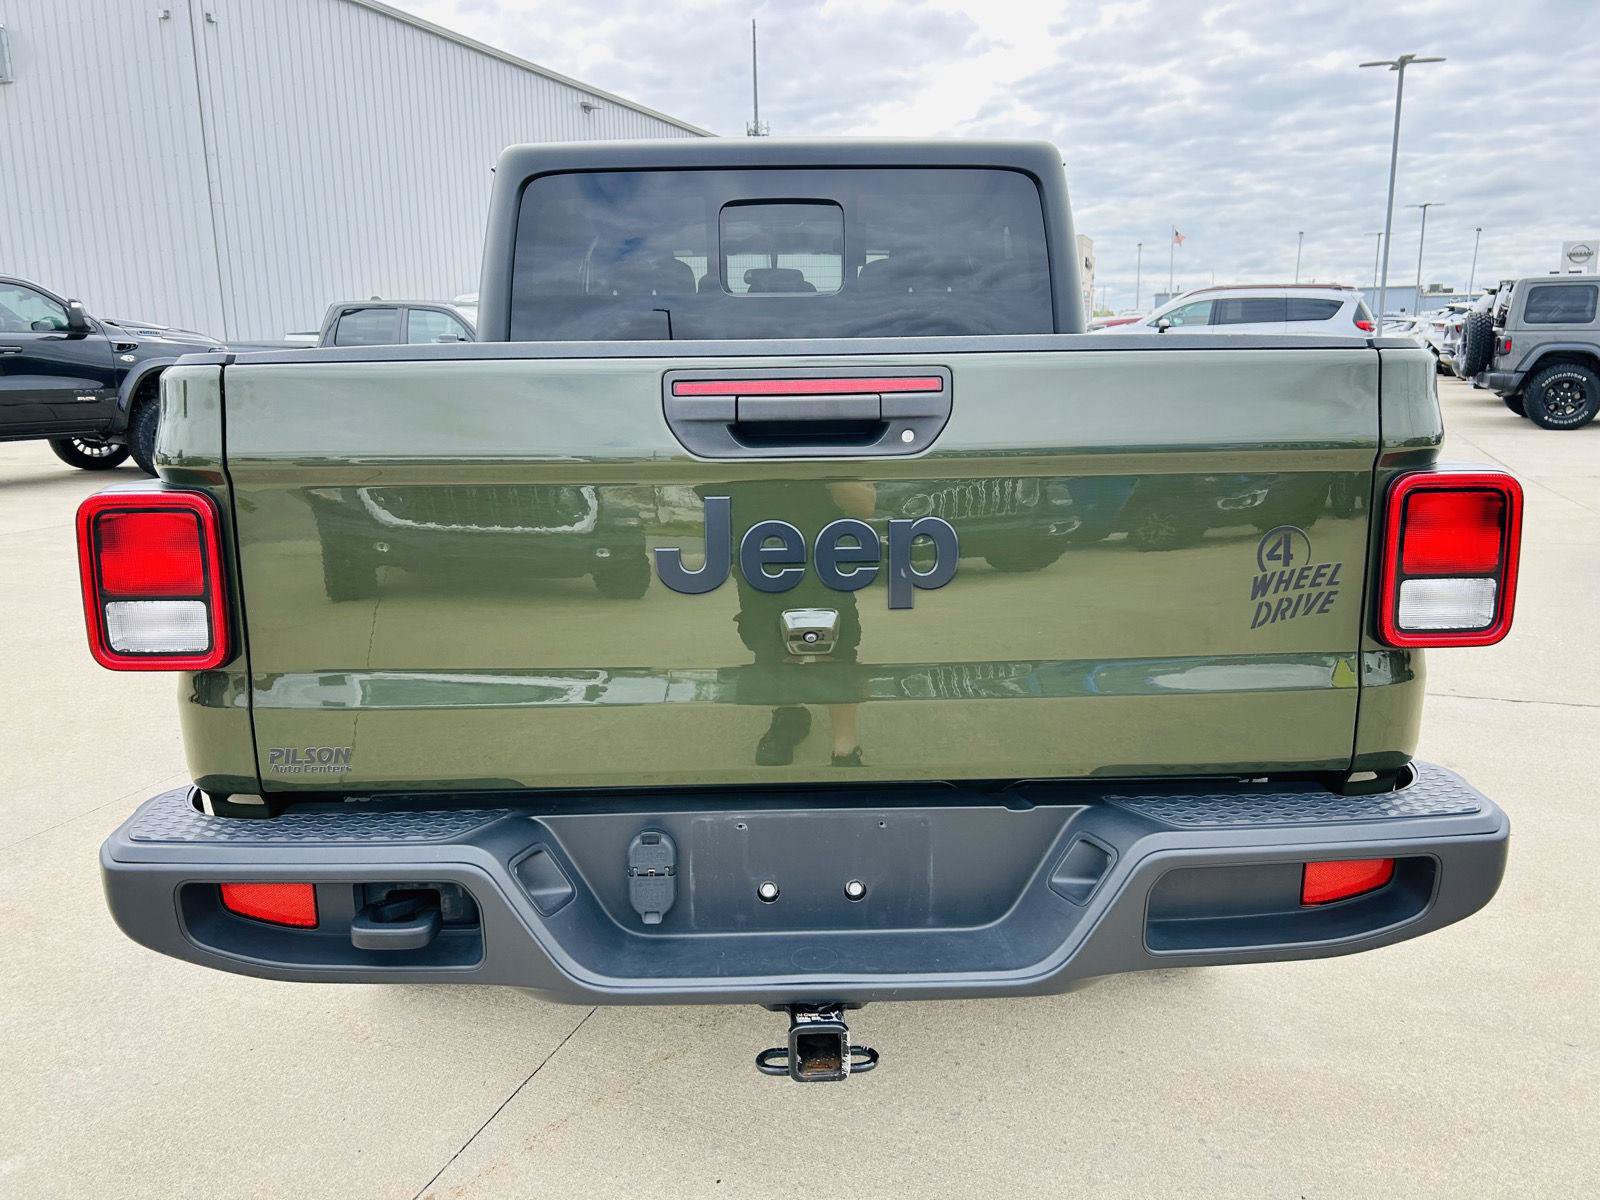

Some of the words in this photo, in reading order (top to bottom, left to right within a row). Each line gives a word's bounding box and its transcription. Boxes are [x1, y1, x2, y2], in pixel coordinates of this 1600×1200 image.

[654, 495, 960, 610] Jeep
[1266, 532, 1294, 567] 4
[1250, 562, 1342, 601] WHEEL
[1250, 590, 1339, 629] DRIVE
[268, 746, 353, 764] PILSON
[270, 763, 301, 774] Auto
